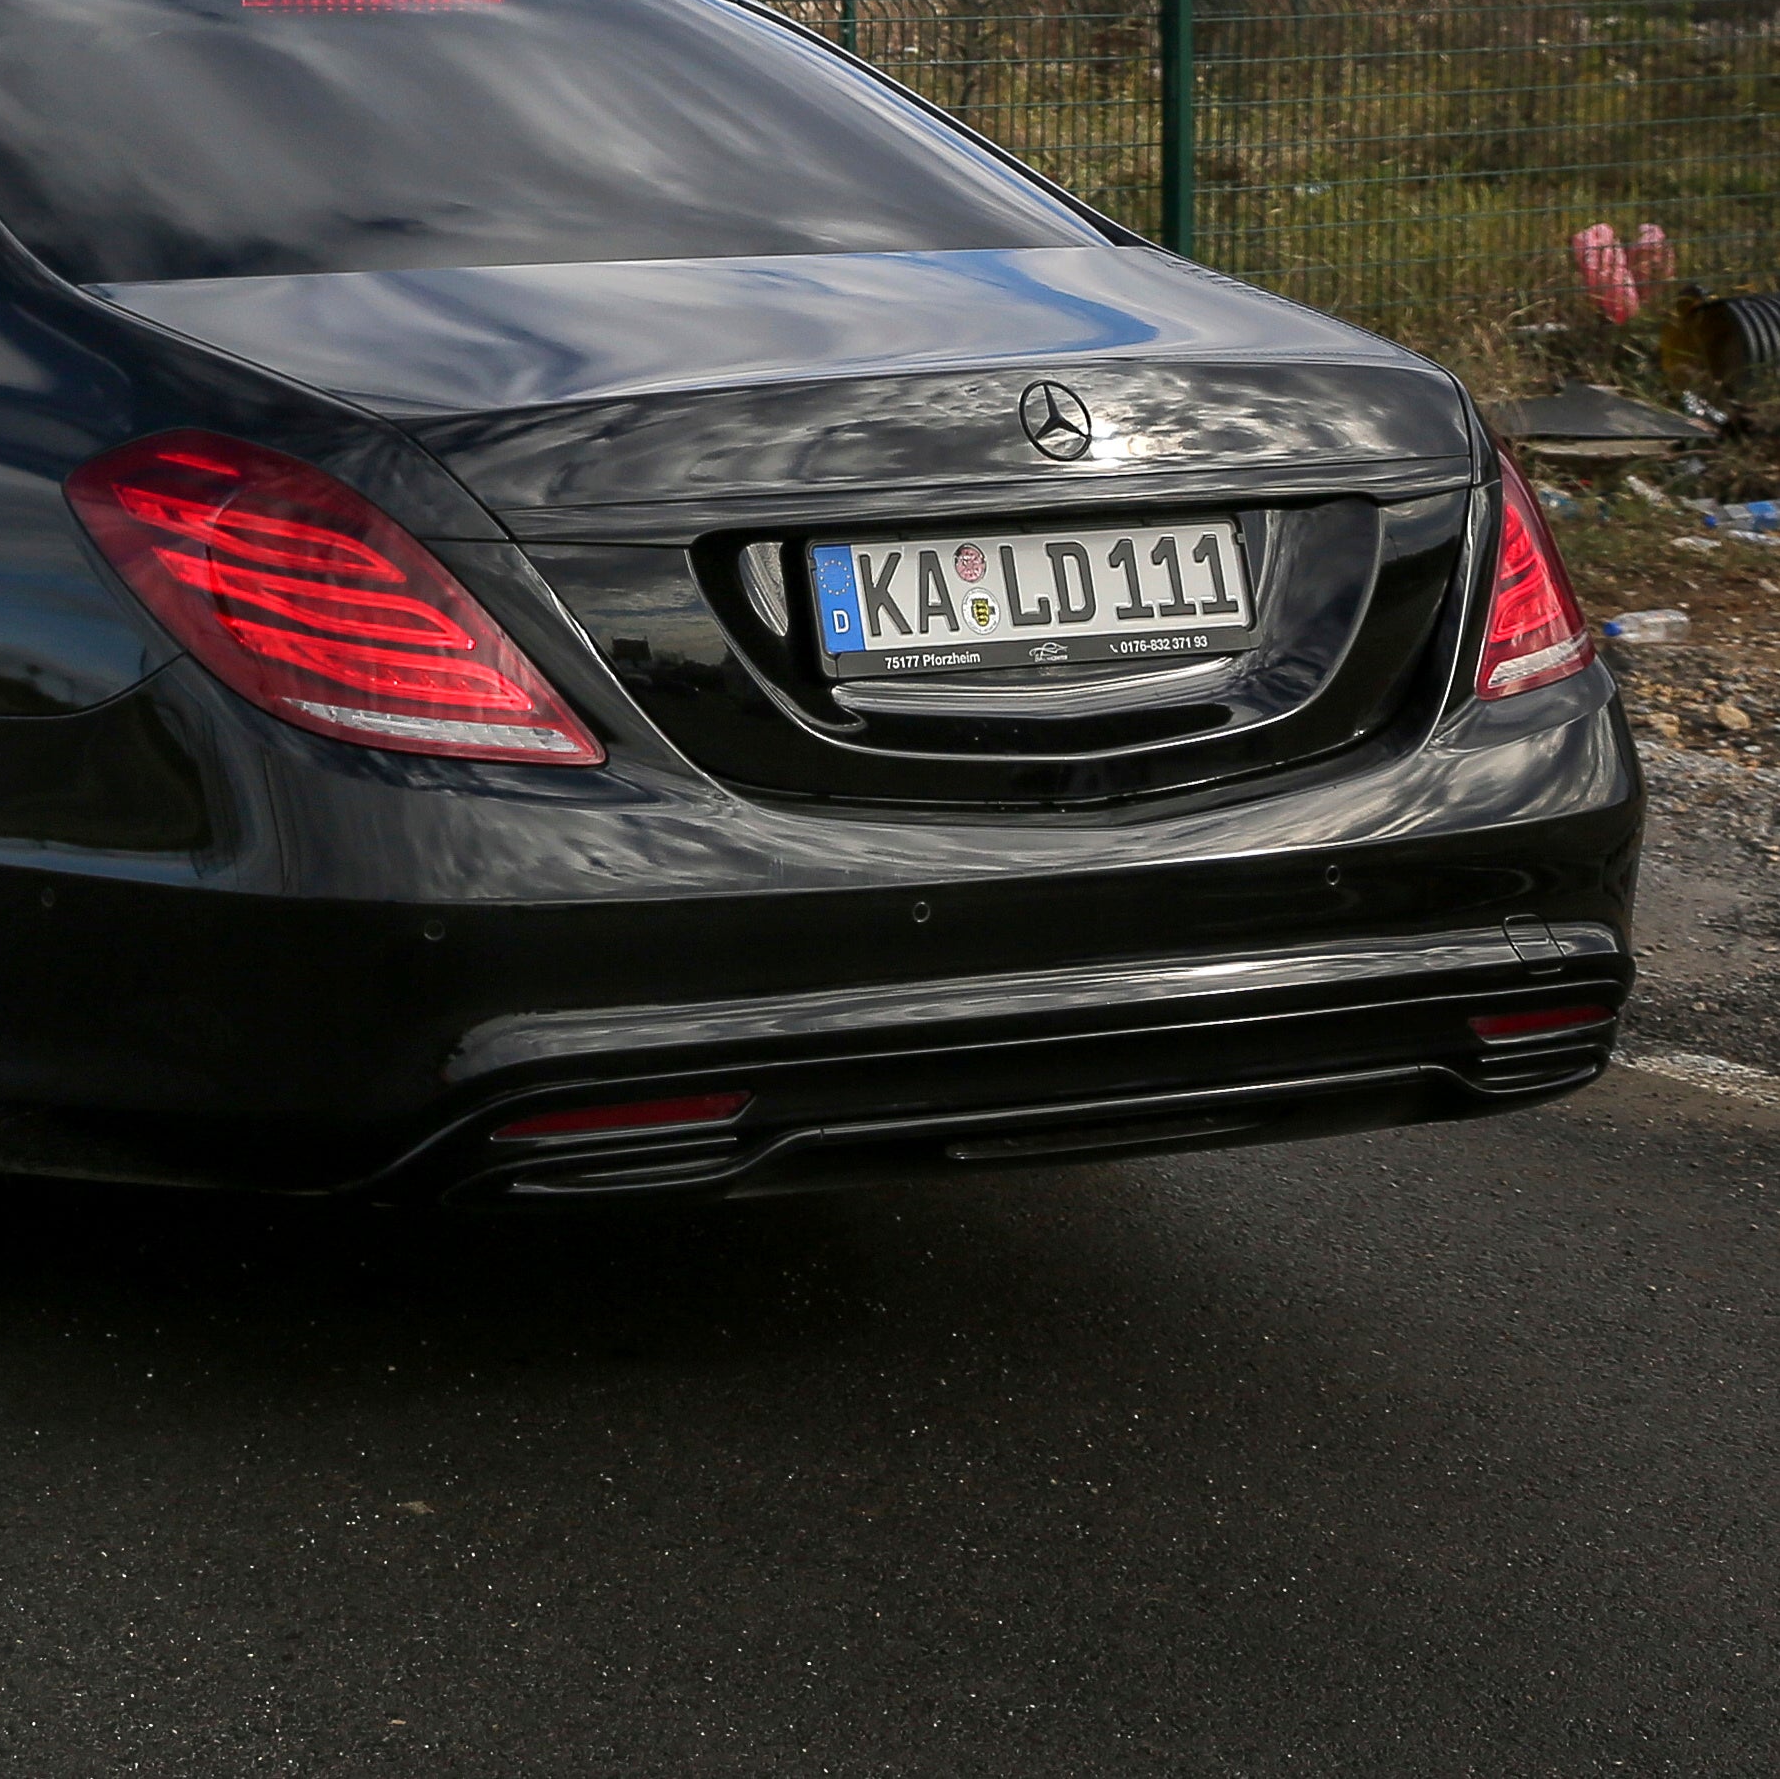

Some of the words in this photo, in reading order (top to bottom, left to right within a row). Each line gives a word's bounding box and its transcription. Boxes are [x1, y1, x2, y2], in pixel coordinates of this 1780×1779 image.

[859, 550, 960, 636] KA
[999, 541, 1096, 627] LD
[1108, 533, 1239, 620] 111
[832, 609, 851, 634] D
[1120, 638, 1171, 654] 0176-832
[1172, 637, 1191, 650] 371
[1194, 635, 1209, 649] 93
[884, 655, 920, 670] 75177
[922, 651, 981, 668] Pforzheim
